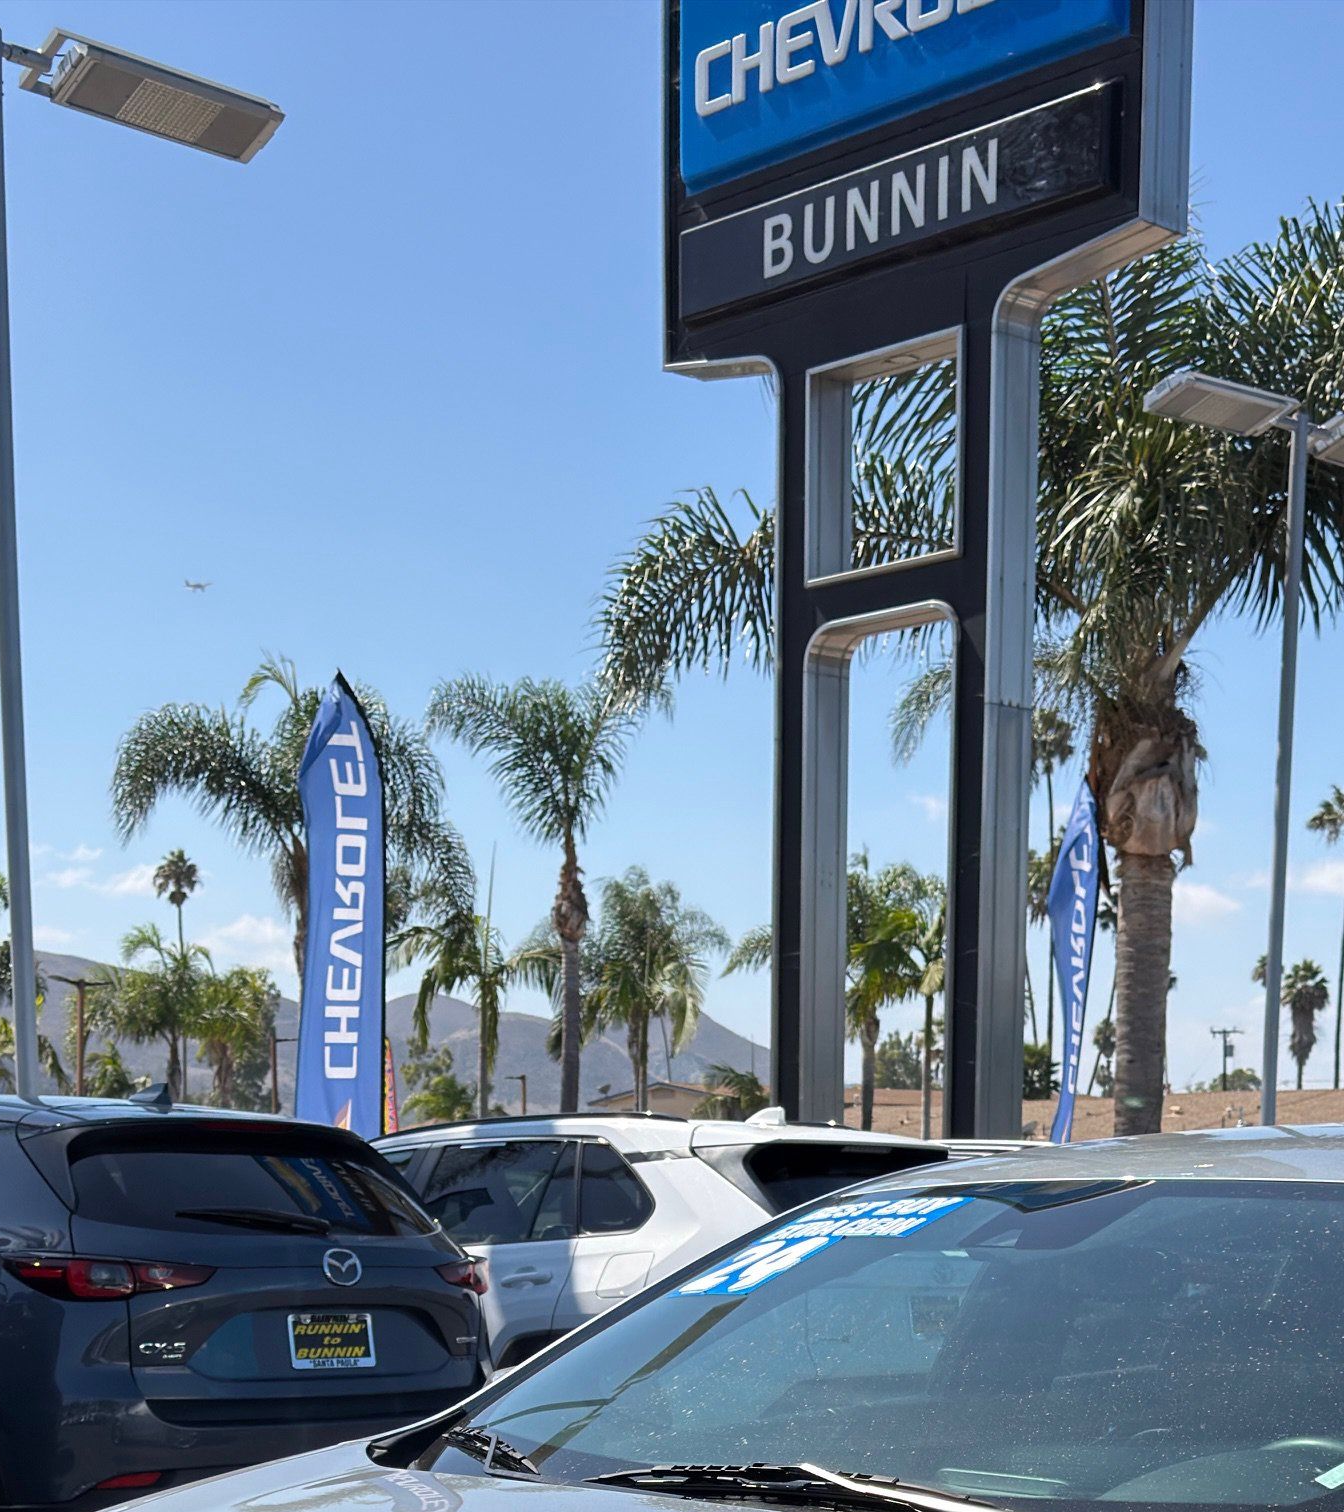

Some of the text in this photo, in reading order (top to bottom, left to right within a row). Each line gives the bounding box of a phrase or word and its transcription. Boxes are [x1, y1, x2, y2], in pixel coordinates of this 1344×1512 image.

[763, 139, 999, 279] BUNNIN
[323, 1336, 342, 1345] to
[296, 1346, 365, 1359] BUNNIN
